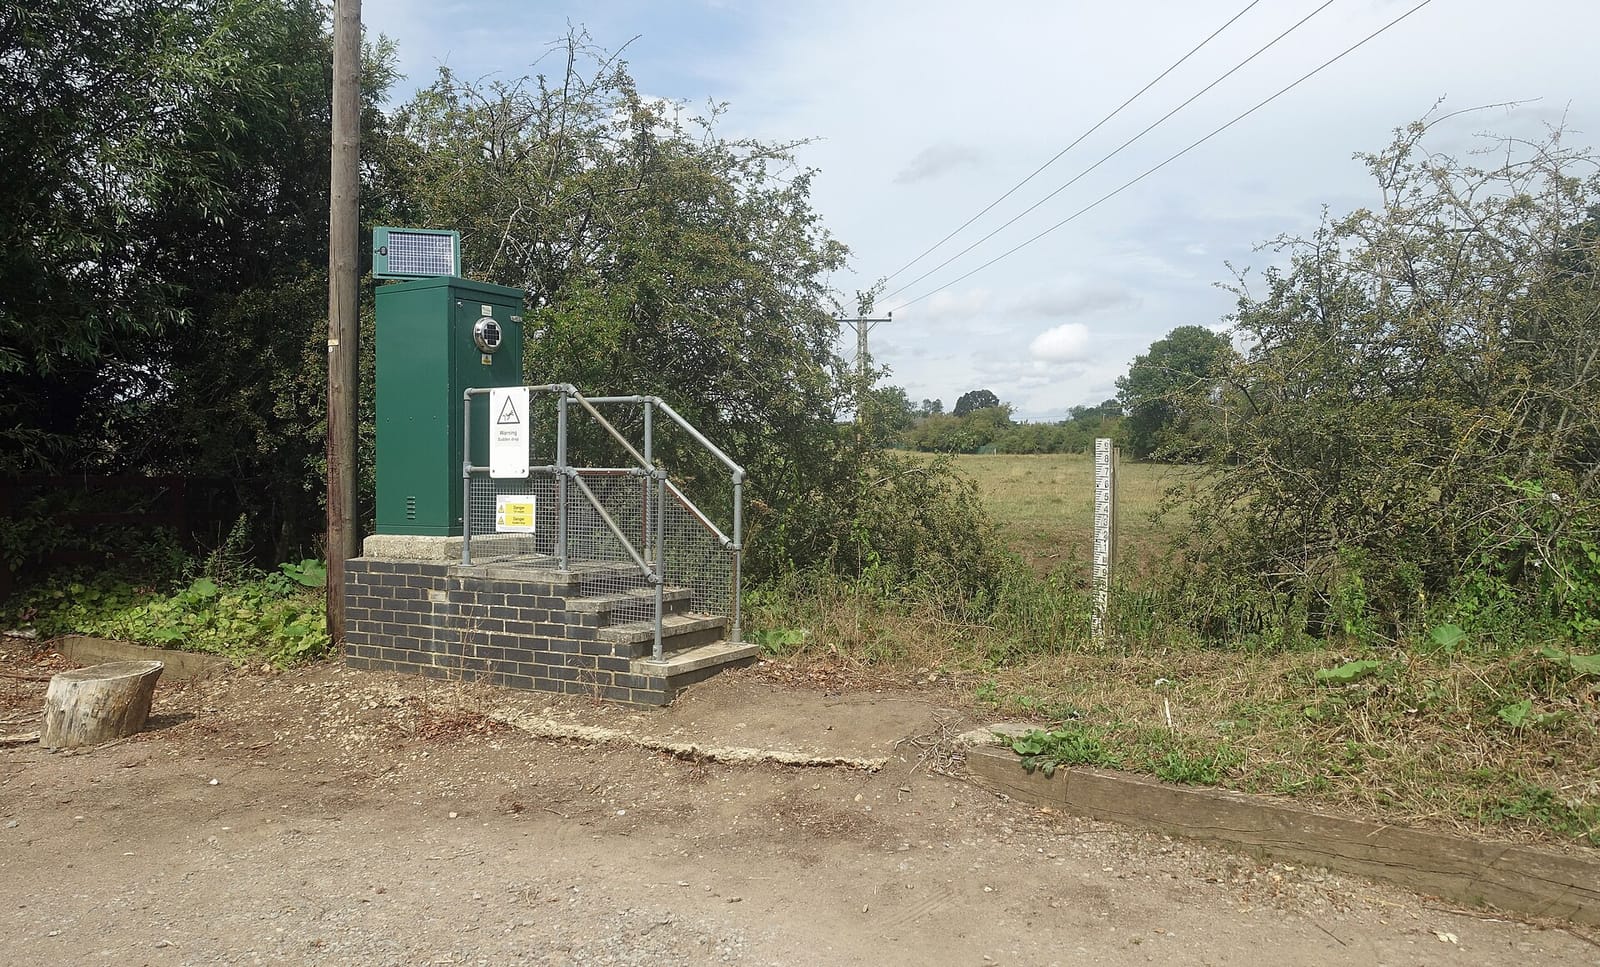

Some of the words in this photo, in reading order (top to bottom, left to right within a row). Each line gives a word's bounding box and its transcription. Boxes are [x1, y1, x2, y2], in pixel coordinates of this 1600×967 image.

[1104, 454, 1108, 462] 8
[1104, 467, 1108, 476] 7
[1104, 480, 1108, 488] 6
[1104, 492, 1108, 500] 5
[1104, 505, 1108, 513] 4
[1104, 518, 1108, 526] 3
[1104, 530, 1108, 539] 2
